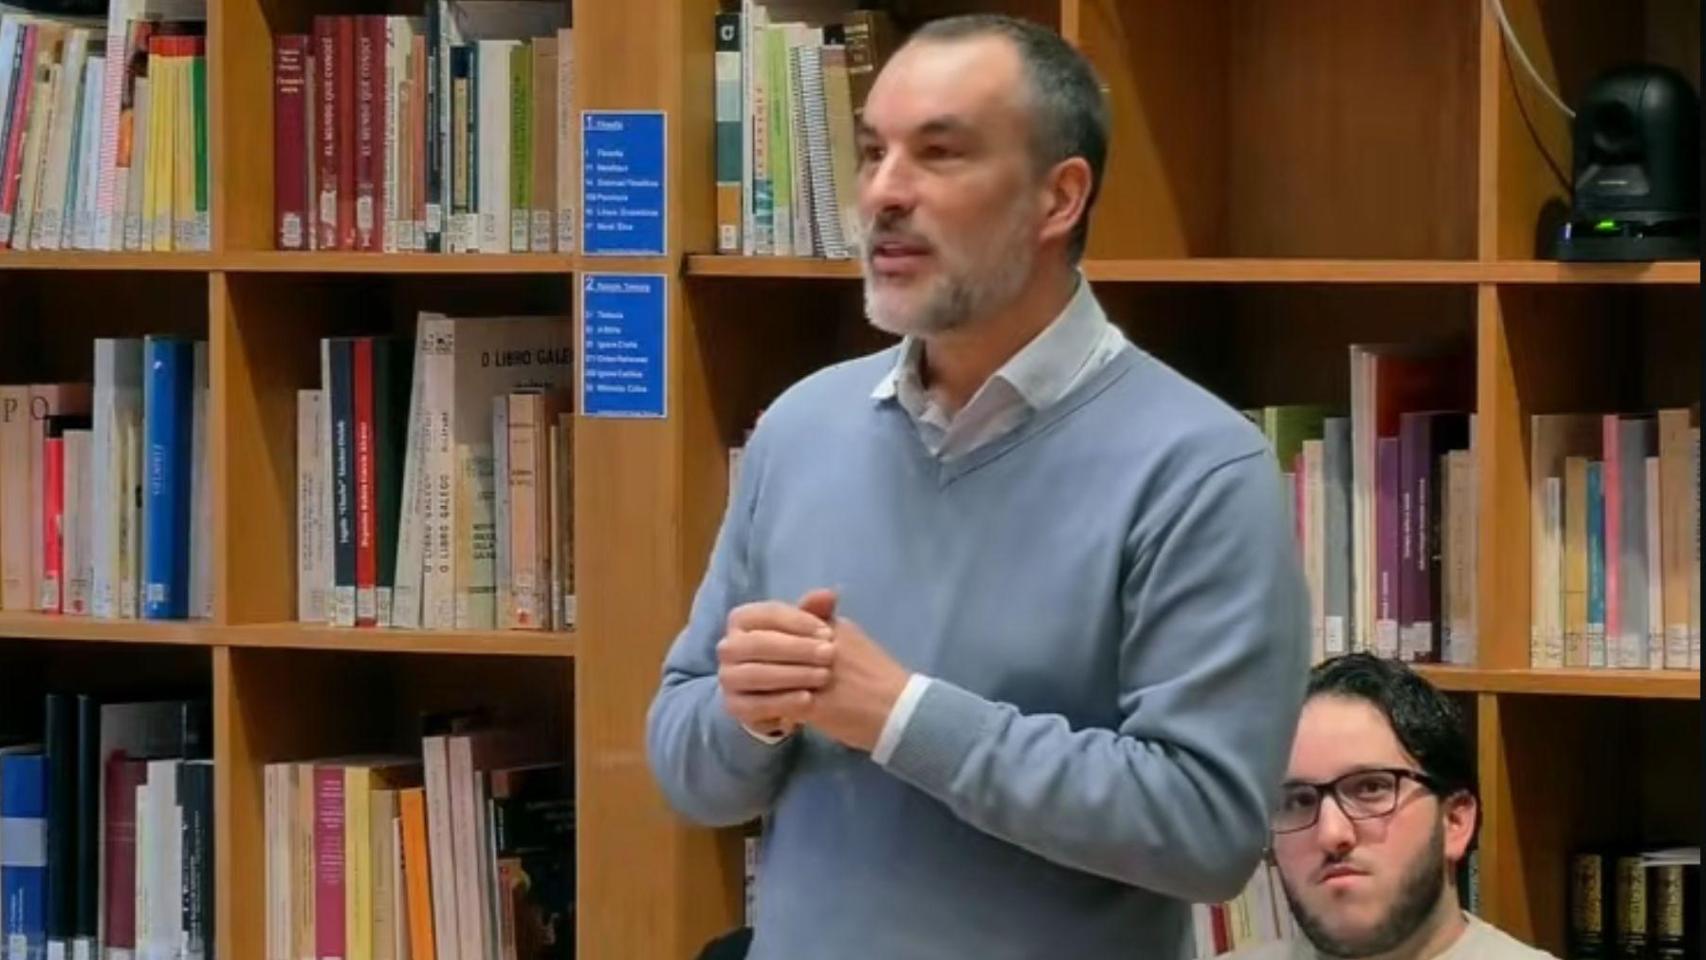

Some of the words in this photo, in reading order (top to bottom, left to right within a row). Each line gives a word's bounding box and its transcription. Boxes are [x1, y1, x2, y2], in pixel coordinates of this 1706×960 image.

[495, 350, 531, 367] LIBRO
[537, 347, 574, 365] GALE
[439, 474, 449, 519] GALEGO
[439, 525, 449, 559] LIBRO
